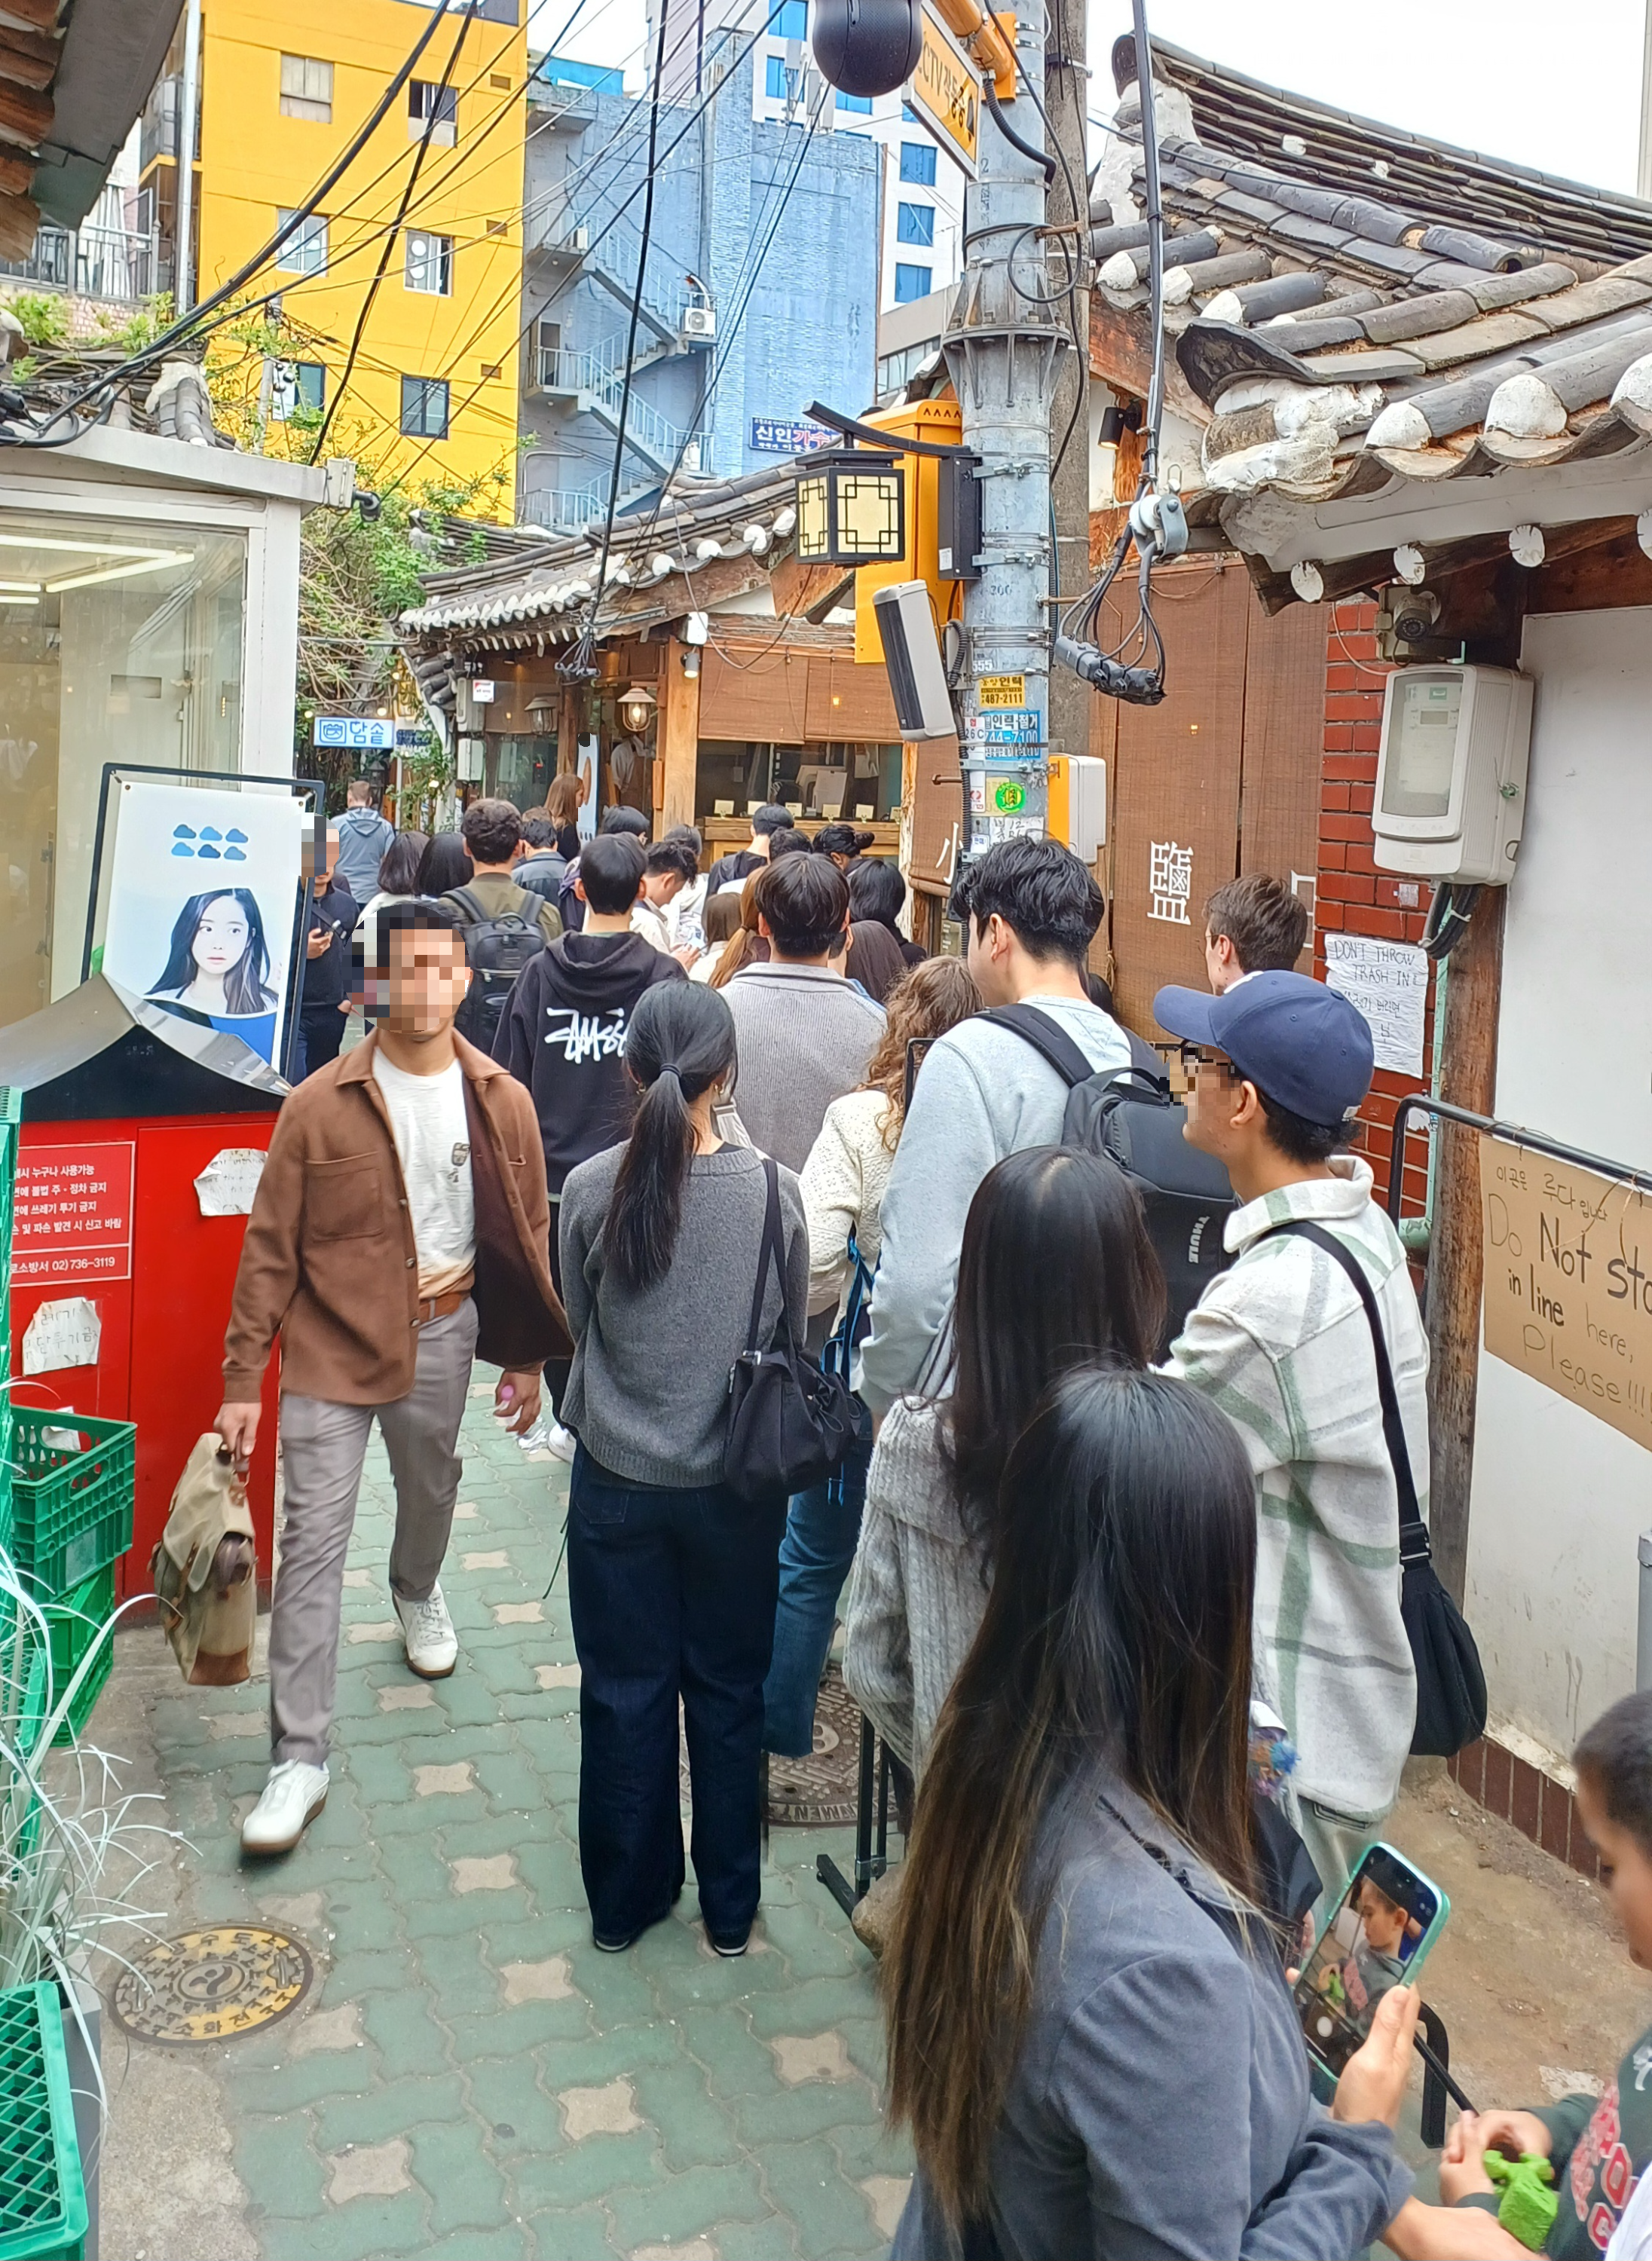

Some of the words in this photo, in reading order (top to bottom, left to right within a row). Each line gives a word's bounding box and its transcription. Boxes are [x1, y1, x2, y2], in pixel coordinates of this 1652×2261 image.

[986, 693, 1022, 704] 487-2111
[350, 721, 384, 744] 담솥
[1334, 941, 1366, 961] DON'T
[1375, 947, 1415, 965] THROW
[1352, 964, 1388, 984] TRASH
[1396, 970, 1409, 987] IN
[32, 1165, 58, 1178] 누구나
[60, 1164, 94, 1176] 사용가능
[32, 1185, 49, 1197] 불법
[51, 1184, 61, 1195] 주
[69, 1183, 87, 1195] 정차
[90, 1182, 107, 1193] 금지
[1543, 1173, 1576, 1210] 루다
[30, 1204, 57, 1215] 쓰레기
[60, 1202, 77, 1213] 투기
[79, 1201, 97, 1213] 금지
[22, 1223, 31, 1235] 및
[33, 1222, 51, 1234] 파손
[54, 1221, 71, 1233] 발견
[73, 1220, 83, 1231] 시
[85, 1219, 102, 1231] 신고
[105, 1218, 122, 1229] 바람
[1488, 1193, 1522, 1257] Do
[1540, 1212, 1592, 1283] Not
[1189, 1216, 1210, 1264] THULE
[1508, 1268, 1522, 1296] in
[1530, 1262, 1565, 1326] line
[1586, 1302, 1633, 1363] here,
